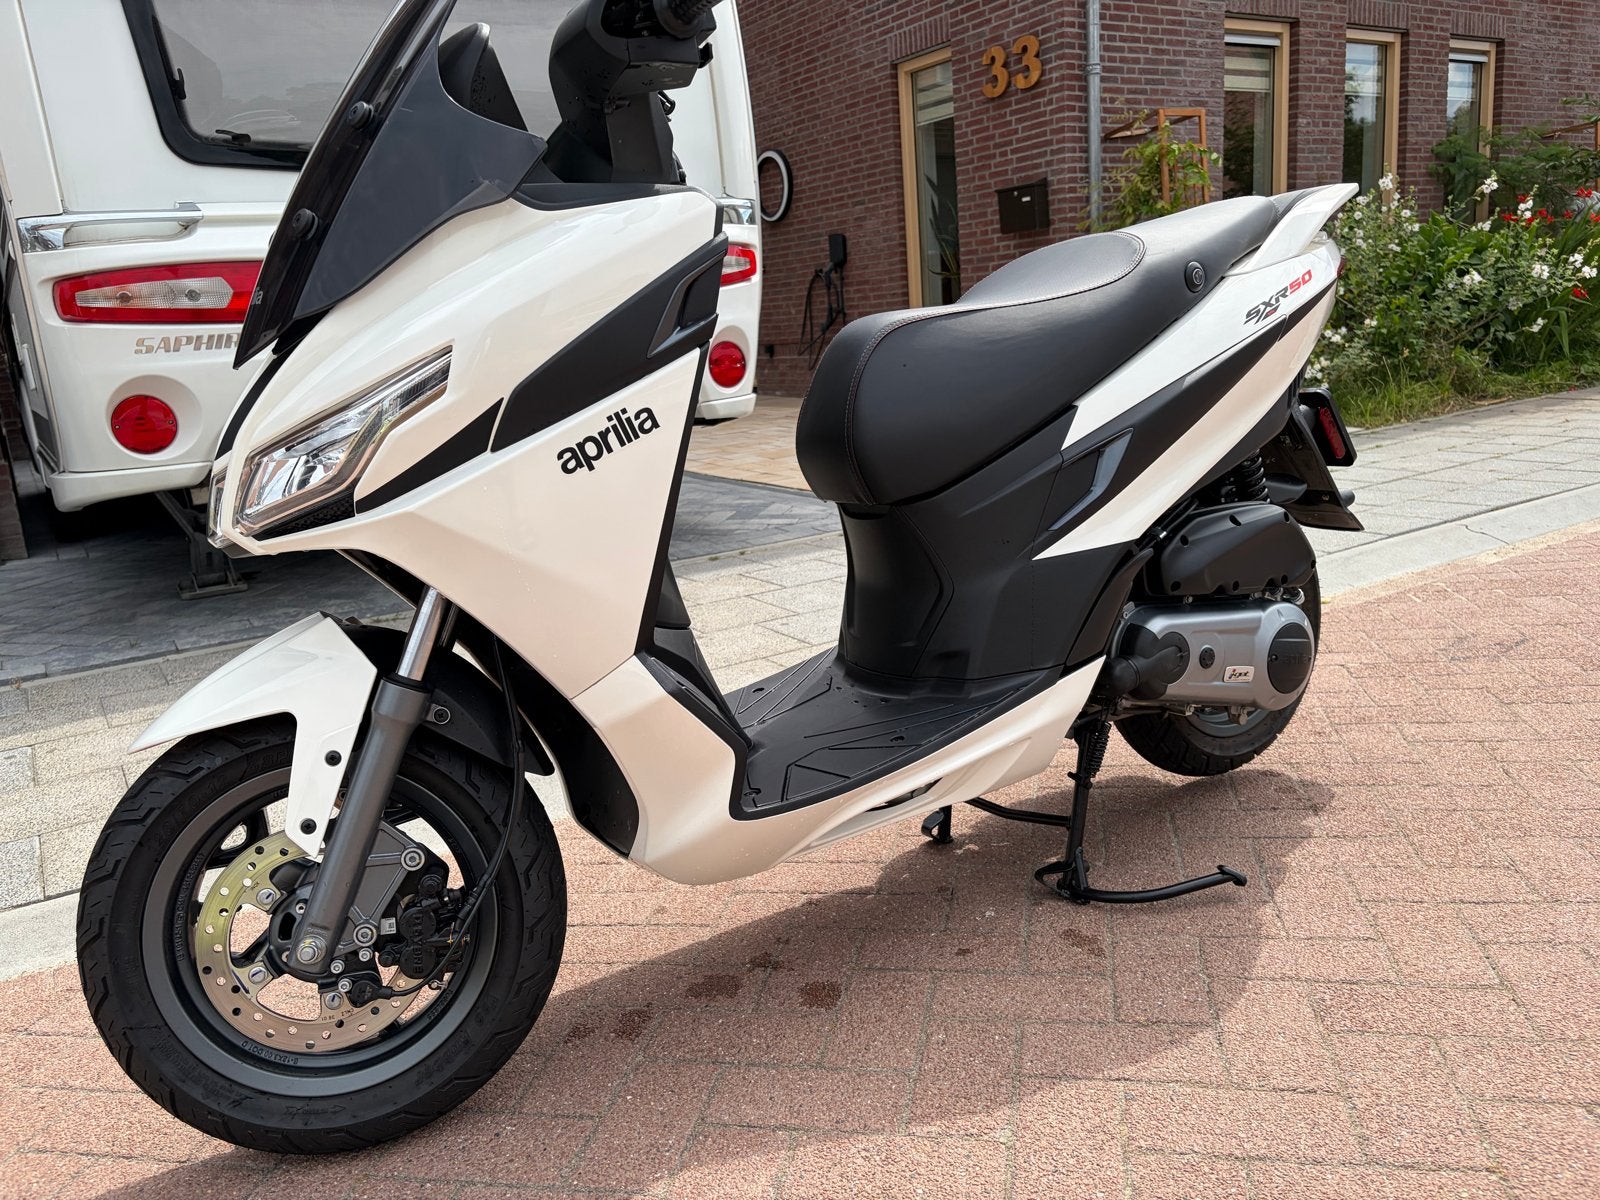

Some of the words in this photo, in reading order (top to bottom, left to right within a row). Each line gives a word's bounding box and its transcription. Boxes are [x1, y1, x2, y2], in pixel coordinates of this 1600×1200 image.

[982, 35, 1042, 98] 33
[1243, 269, 1312, 325] SXR50
[134, 332, 240, 355] SAPHIR
[557, 407, 661, 475] aprilia
